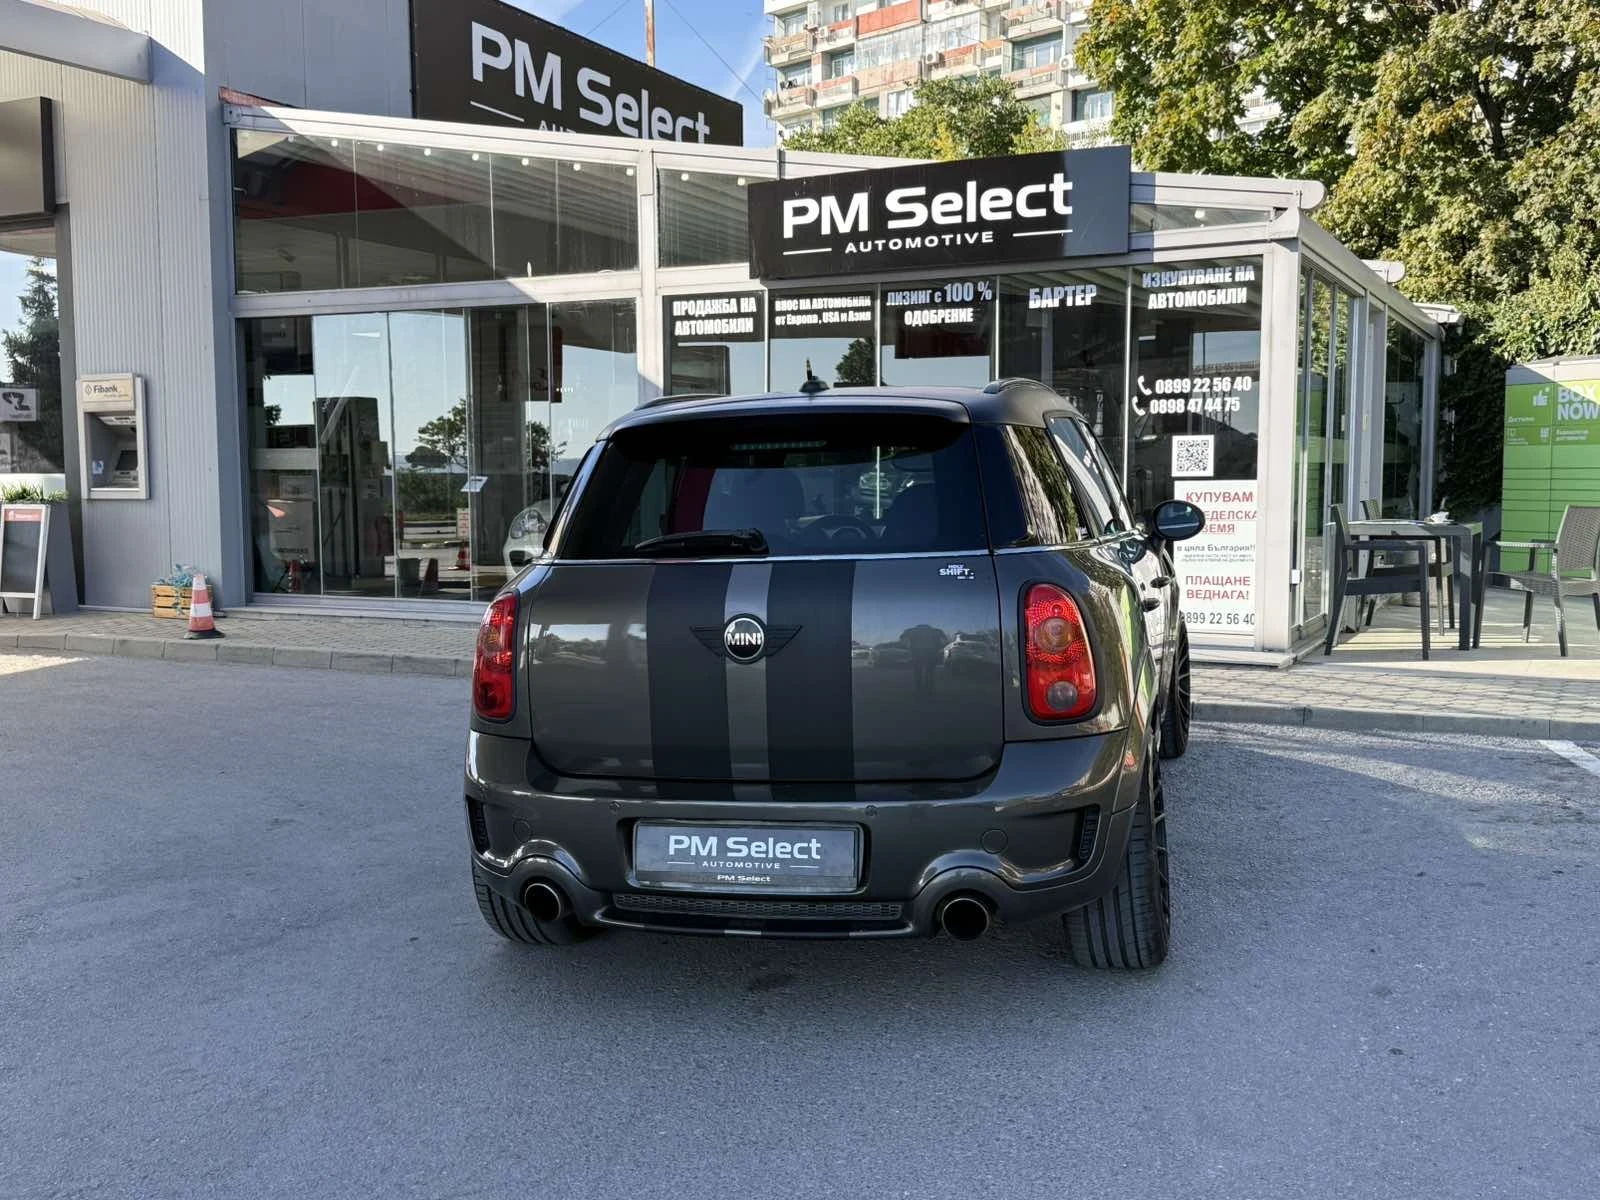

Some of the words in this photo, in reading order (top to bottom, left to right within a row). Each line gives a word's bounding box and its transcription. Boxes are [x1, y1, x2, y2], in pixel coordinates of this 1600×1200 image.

[471, 21, 562, 110] PM
[576, 66, 710, 144] Select
[783, 192, 869, 239] PM
[885, 172, 1073, 229] Select
[845, 231, 994, 254] AUTOMOTIVE
[1142, 267, 1232, 288] ИЗКУПУВАНЕ
[1235, 265, 1255, 282] НА
[886, 289, 932, 306] ЛИЗИНГ
[943, 282, 974, 303] 100
[977, 281, 993, 301] %
[1028, 284, 1097, 309] БАРТЕР
[1147, 287, 1247, 309] АВТОМОБИЛИ
[673, 298, 738, 317] ПРОДАЖБА
[740, 297, 757, 313] НА
[775, 299, 799, 312] ВНОС
[799, 298, 812, 311] НА
[812, 295, 871, 309] АВТОМОБИЛИ
[674, 317, 754, 336] АВТОМОБИЛИ
[775, 315, 786, 326] от
[822, 311, 840, 323] USA
[904, 307, 974, 327] ОДОБРЕНИЕ
[1155, 378, 1191, 394] 0899
[1193, 377, 1211, 393] 22
[1212, 376, 1232, 392] 56
[1233, 375, 1252, 391] 40
[1149, 398, 1185, 414] 0898
[1187, 397, 1203, 413] 47
[1204, 397, 1222, 413] 44
[1223, 396, 1241, 412] 75
[1557, 402, 1600, 421] NOW
[1186, 491, 1253, 503] КУПУВАМ
[1185, 575, 1251, 587] ПЛАЩАНЕ
[1186, 589, 1249, 601] ВЕДНАГА!
[1209, 612, 1223, 625] 22
[1226, 613, 1240, 625] 56
[727, 632, 762, 646] MINI
[669, 835, 717, 856] PM
[726, 837, 822, 860] Select
[702, 860, 781, 869] AUTOMOTIVE
